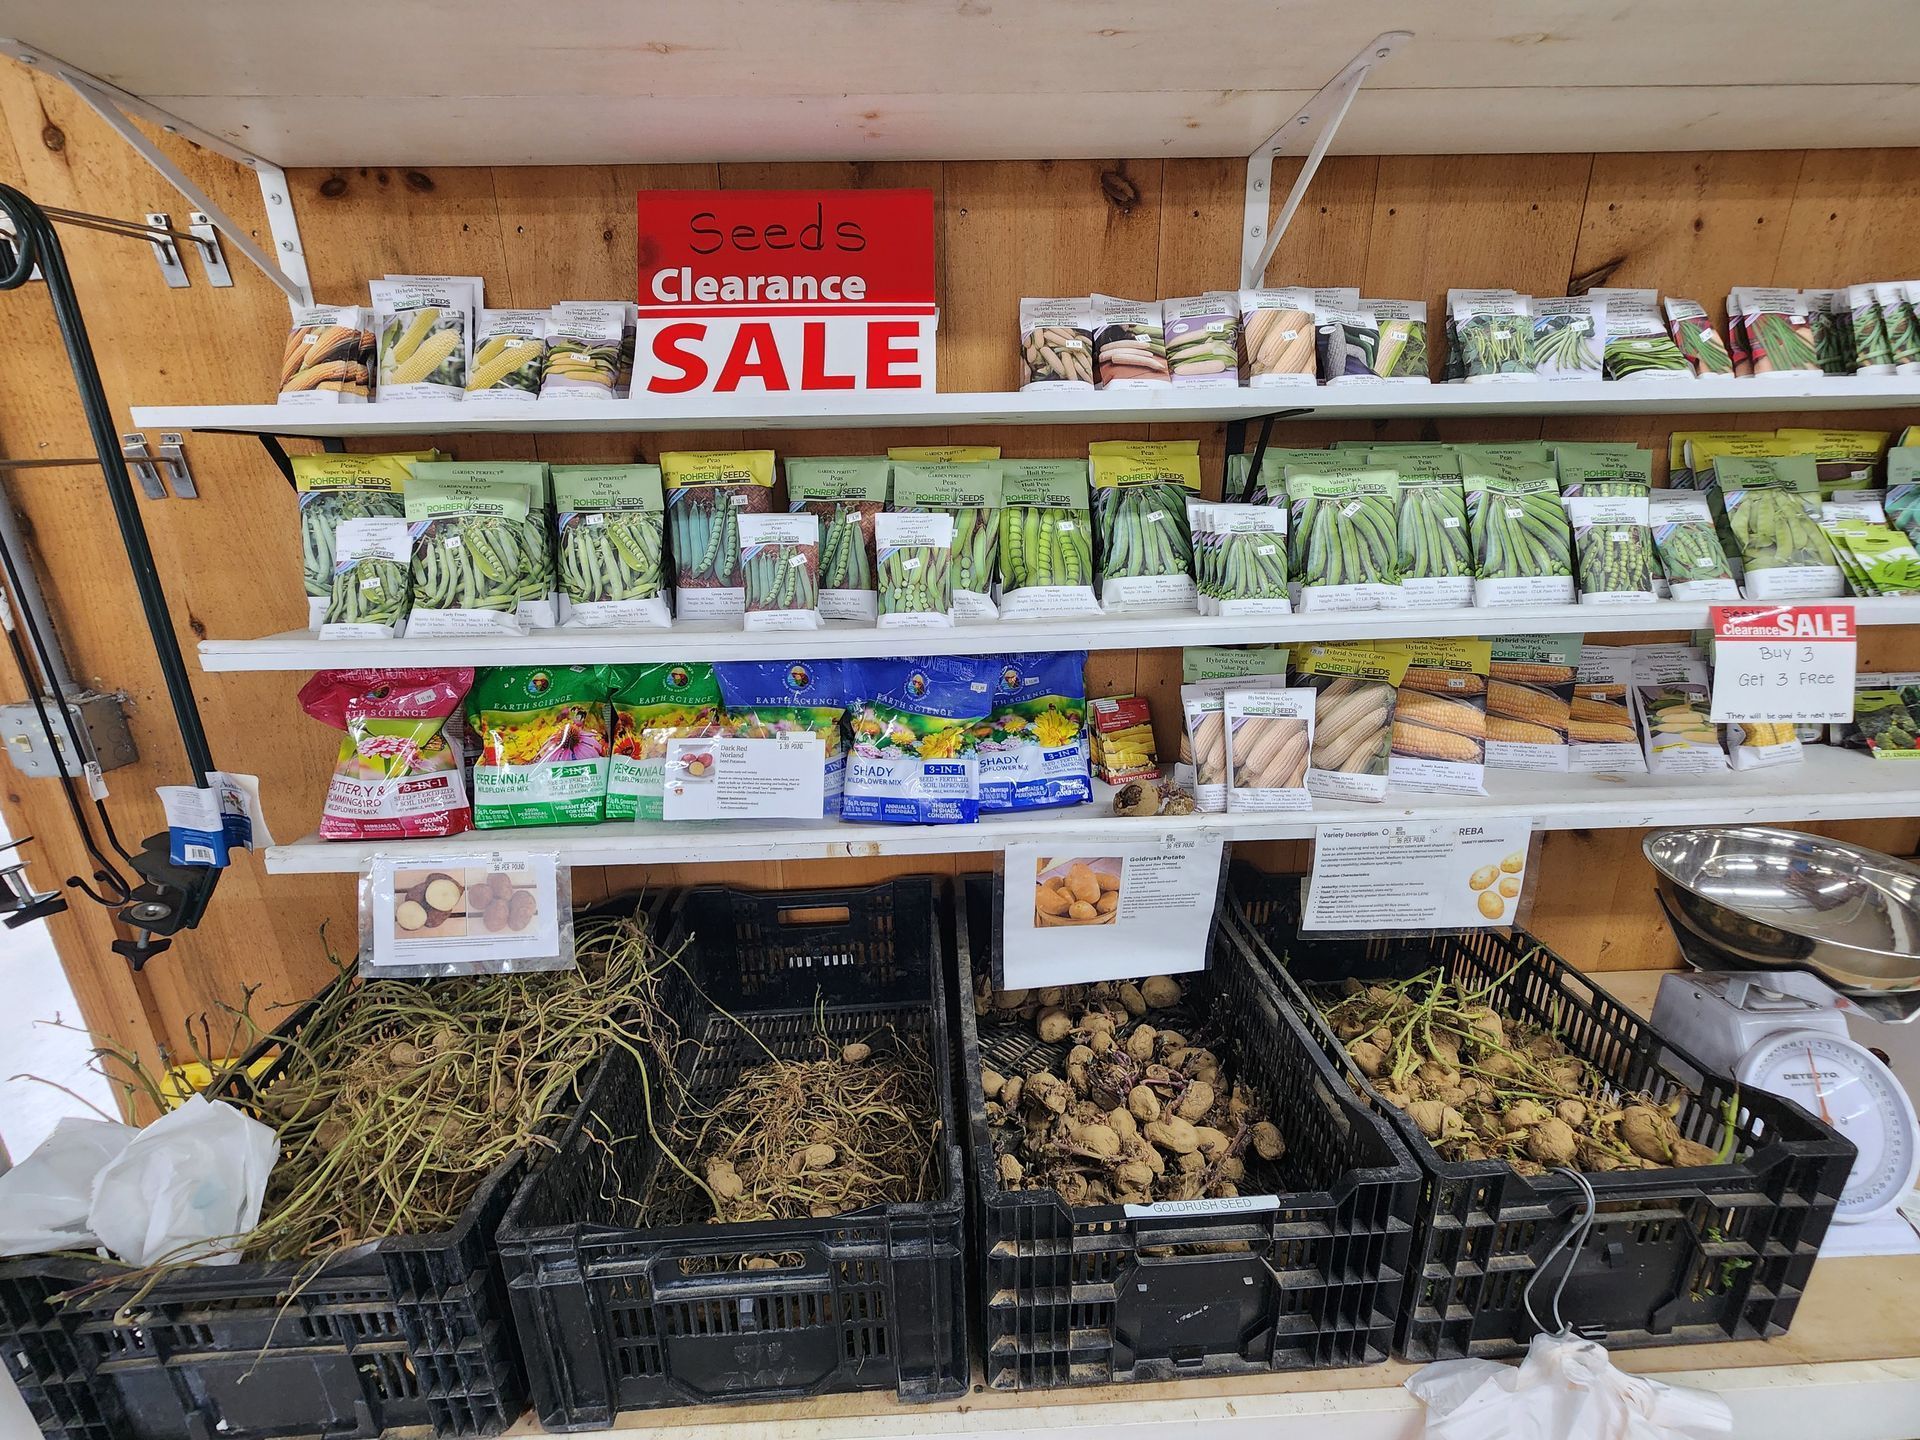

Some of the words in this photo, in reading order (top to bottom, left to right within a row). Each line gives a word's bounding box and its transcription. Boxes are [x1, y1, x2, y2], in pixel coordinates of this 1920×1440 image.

[690, 202, 866, 254] Seeds
[651, 266, 866, 302] Clearance
[393, 299, 421, 308] ROHRER
[647, 322, 922, 394] SALE
[310, 476, 347, 485] ROHRER
[358, 477, 391, 485] SEEDS
[680, 472, 714, 481] ROHRER
[723, 471, 750, 479] SEEDS
[1117, 473, 1152, 482] ROHRER
[1517, 480, 1548, 490] SEEDS
[427, 504, 463, 512] ROHRER
[574, 498, 608, 506] ROHRER
[1722, 624, 1780, 635] Clearance
[1777, 614, 1847, 636] SALE
[1759, 647, 1791, 660] Buy
[1800, 647, 1814, 662] 3
[1315, 662, 1352, 673] ROHRER
[1362, 667, 1390, 675] SEEDS
[1739, 673, 1764, 687] Get
[1776, 673, 1788, 687] 3
[532, 695, 572, 709] SCIENCE
[640, 696, 666, 704] EARTH
[670, 696, 714, 704] SCIENCE
[1009, 689, 1051, 703] SCIENCE
[877, 693, 906, 711] EARTH
[909, 704, 953, 716] SCIENCE
[1726, 712, 1745, 720] They
[980, 755, 1020, 768] SHADY
[614, 764, 664, 776] PERENNIAL
[853, 764, 893, 777] SHADY
[477, 773, 529, 785] PERENNIAL
[1459, 827, 1483, 835] REBA
[1783, 1072, 1837, 1080] DETECTO
[1153, 1201, 1218, 1212] GOLDRUSH
[1221, 1199, 1251, 1209] SEED
